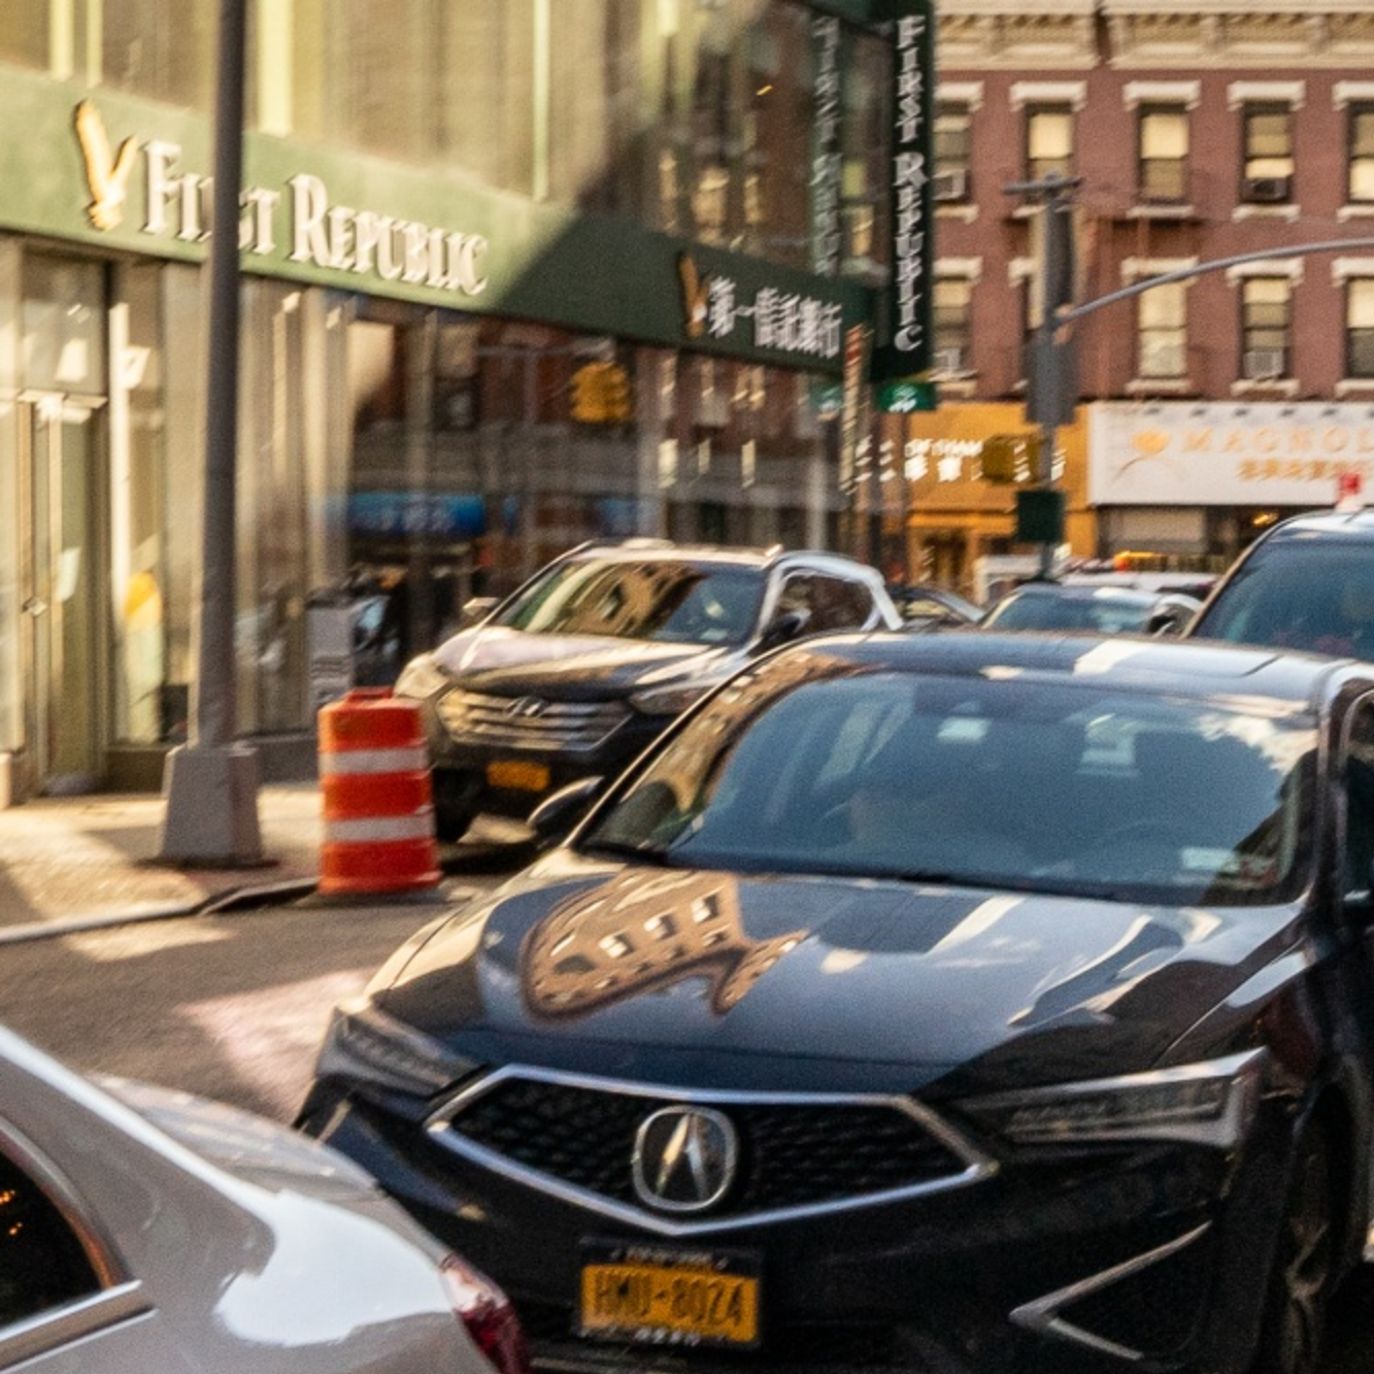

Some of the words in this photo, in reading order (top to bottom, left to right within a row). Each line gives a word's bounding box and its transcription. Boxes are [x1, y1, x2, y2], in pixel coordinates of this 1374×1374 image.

[895, 15, 926, 143] FIRST
[288, 173, 489, 296] REPUBLIC
[893, 151, 929, 351] REPUBLIC
